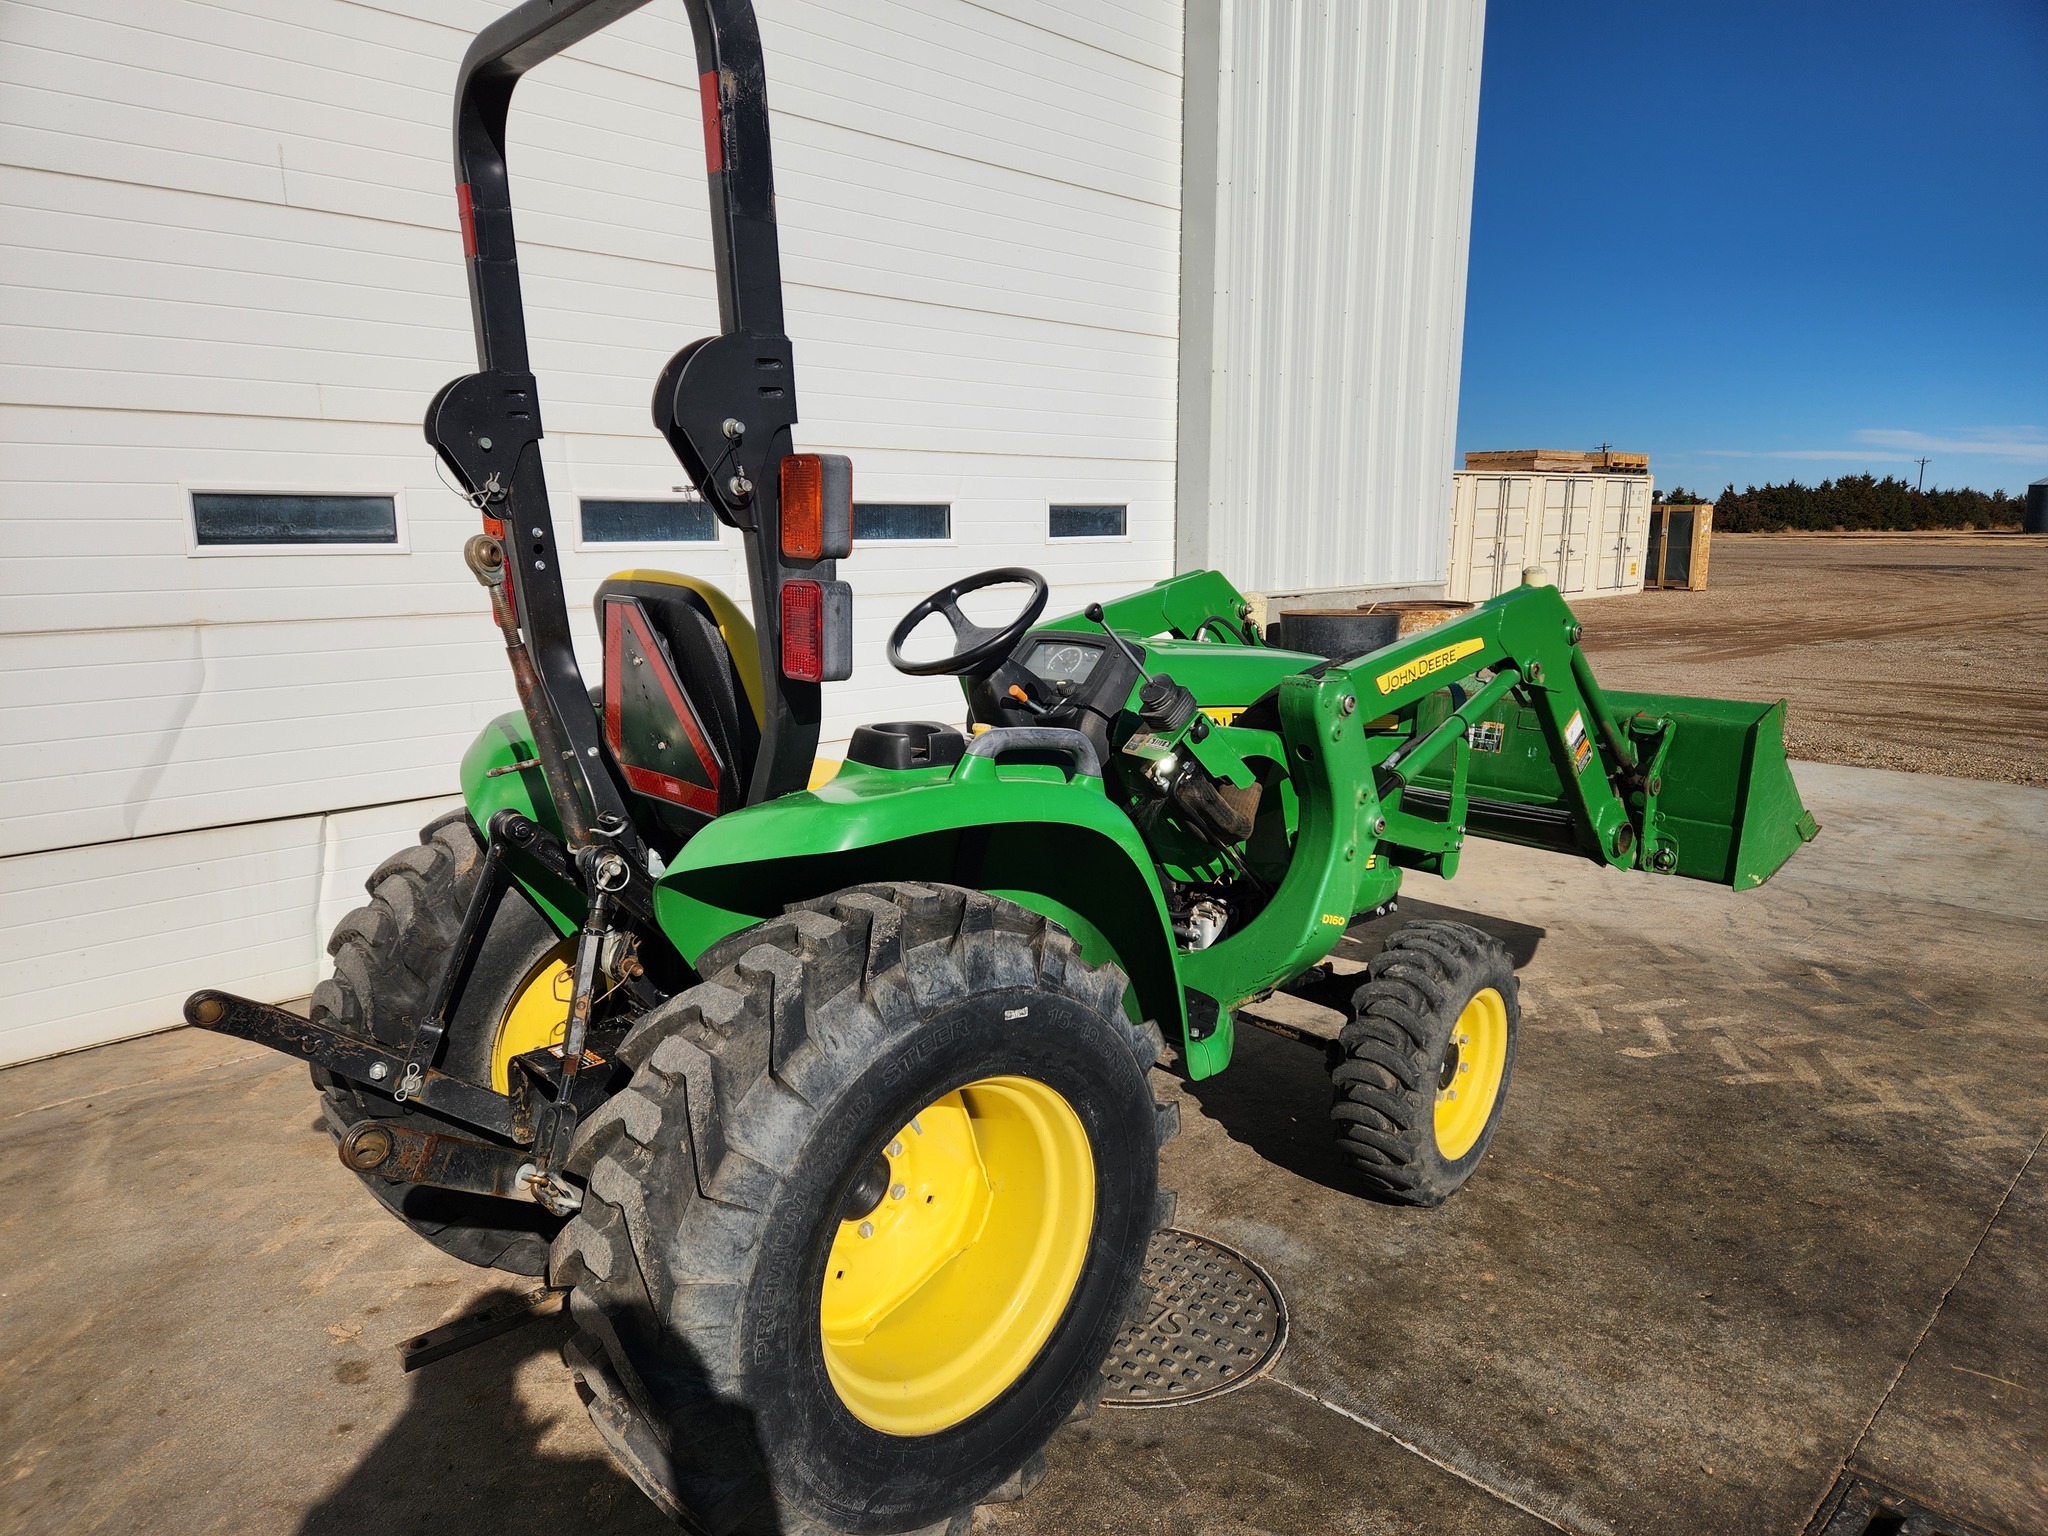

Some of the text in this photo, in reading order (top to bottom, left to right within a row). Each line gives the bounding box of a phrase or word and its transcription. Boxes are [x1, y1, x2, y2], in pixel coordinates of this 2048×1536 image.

[1384, 649, 1457, 693] JOHN DEERE
[1321, 914, 1346, 926] D160
[754, 1190, 810, 1365] PREMIUM
[881, 1018, 971, 1087] STEER
